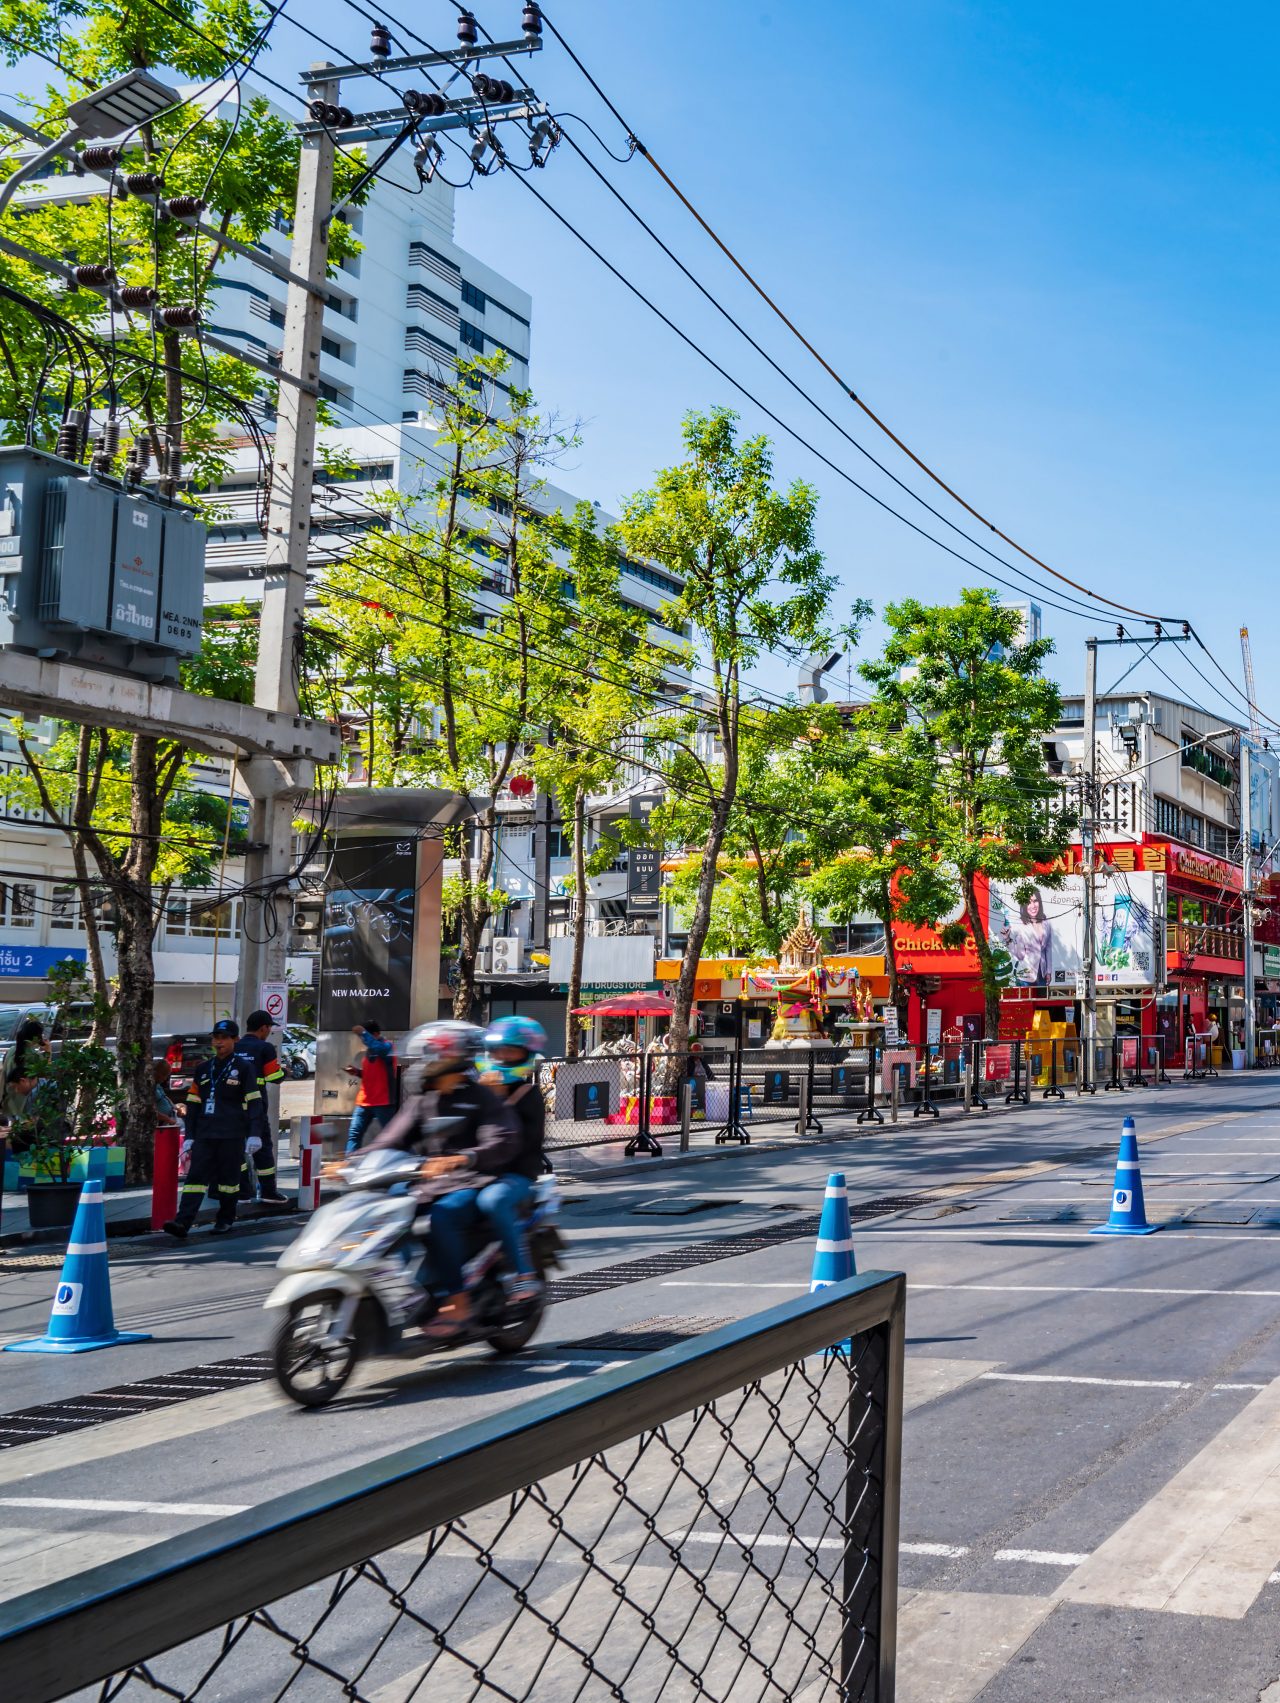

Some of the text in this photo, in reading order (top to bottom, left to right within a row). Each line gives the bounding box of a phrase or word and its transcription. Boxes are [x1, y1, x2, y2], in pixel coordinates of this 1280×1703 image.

[24, 955, 33, 967] 2
[594, 981, 647, 989] DRUGSTORE
[331, 988, 390, 997] NEW MAZDA 2
